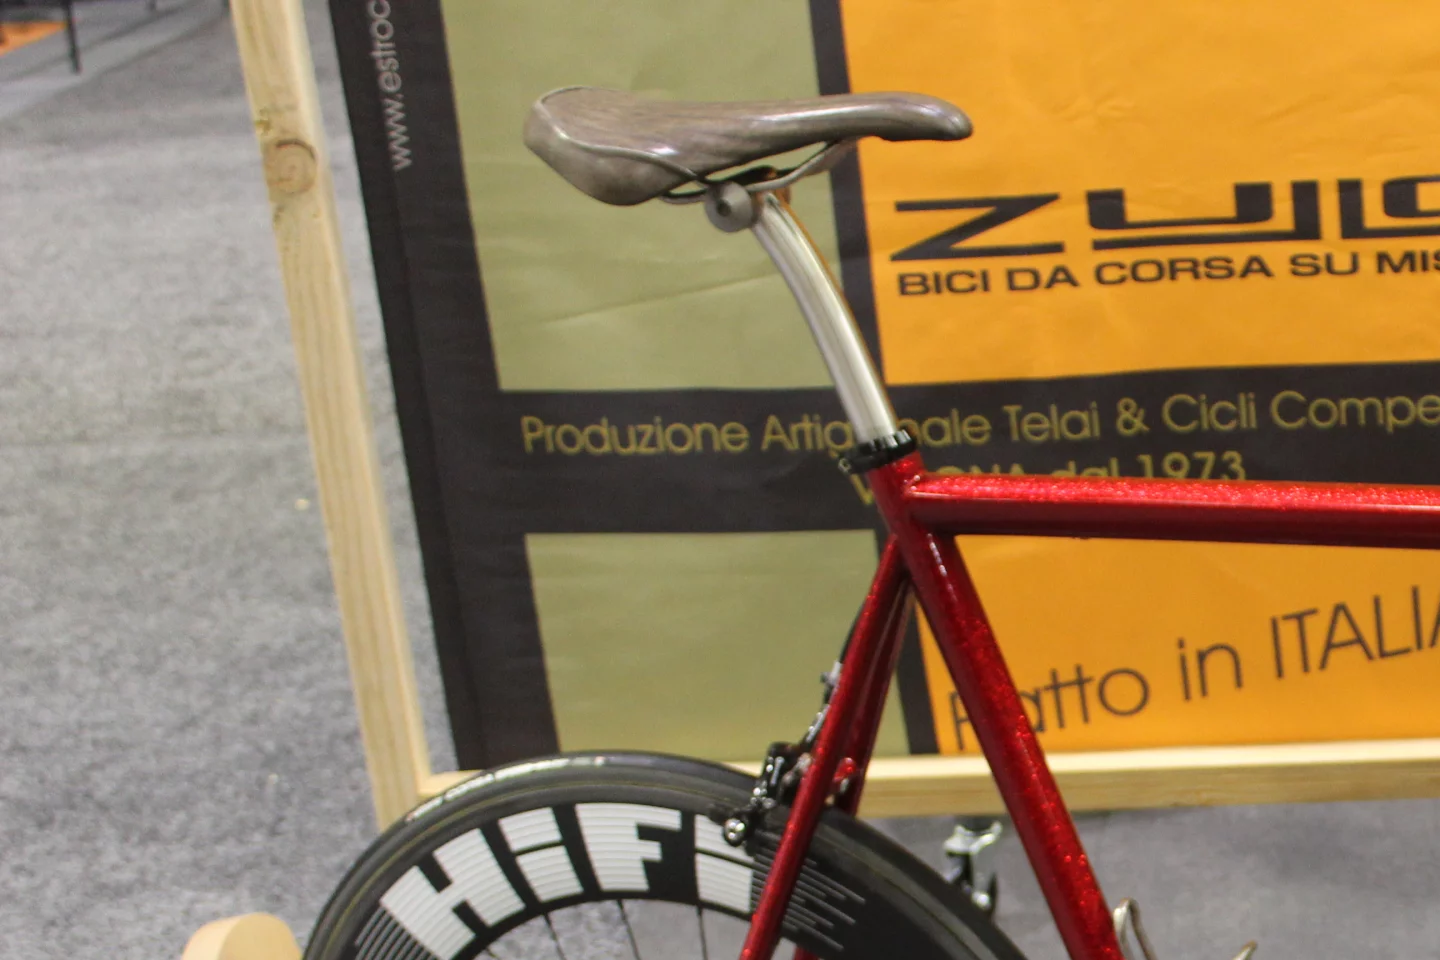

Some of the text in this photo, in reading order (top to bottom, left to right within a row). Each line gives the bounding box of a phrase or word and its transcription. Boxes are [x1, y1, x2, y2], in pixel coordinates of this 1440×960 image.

[899, 269, 991, 297] BICI
[1006, 264, 1080, 292] DA
[1094, 254, 1273, 287] CORSA
[1289, 250, 1361, 279] SU
[520, 413, 750, 457] Produzione
[1005, 400, 1101, 443] Telai
[1115, 399, 1149, 434] &
[1162, 389, 1257, 432] Cicli
[1176, 637, 1243, 703] in
